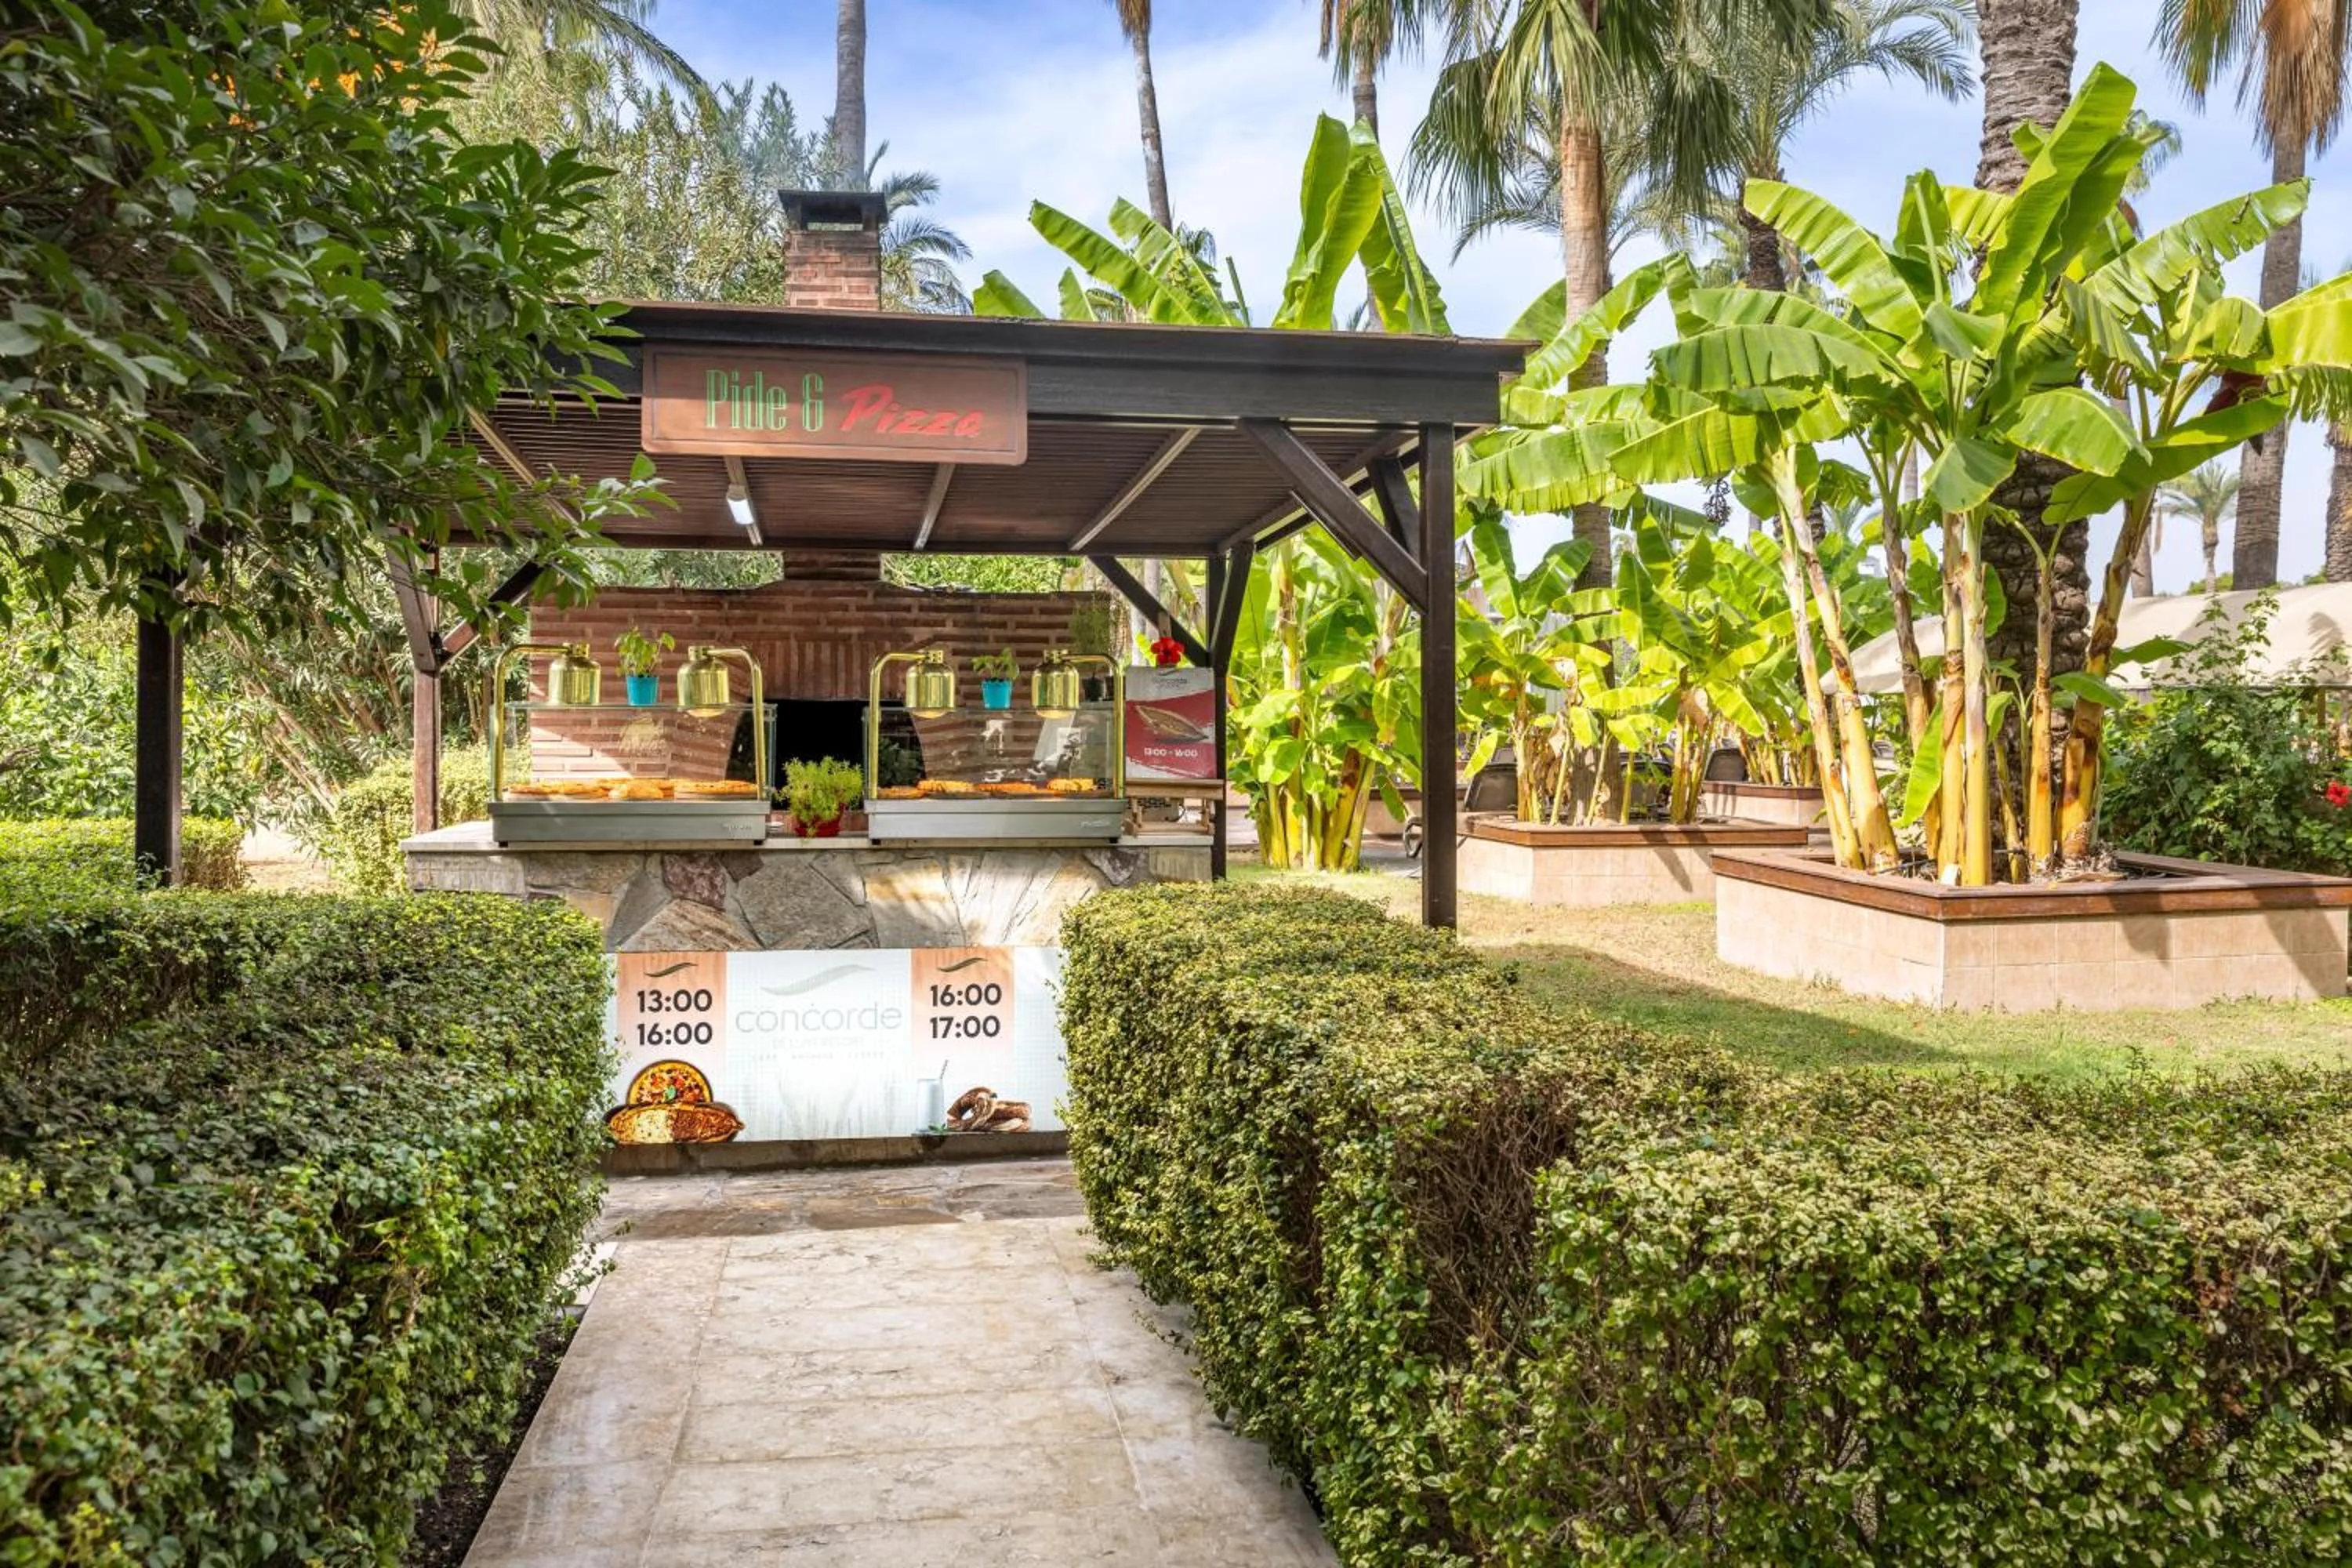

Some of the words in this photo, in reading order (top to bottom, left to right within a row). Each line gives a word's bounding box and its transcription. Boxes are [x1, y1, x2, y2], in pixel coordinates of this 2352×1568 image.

[705, 369, 787, 431] Pide
[840, 383, 985, 438] Pizza
[637, 989, 713, 1013] 13:00
[930, 982, 1002, 1007] 16:00
[735, 1002, 902, 1033] concorde
[930, 1014, 1001, 1039] 17:00
[637, 1022, 713, 1046] 16:00
